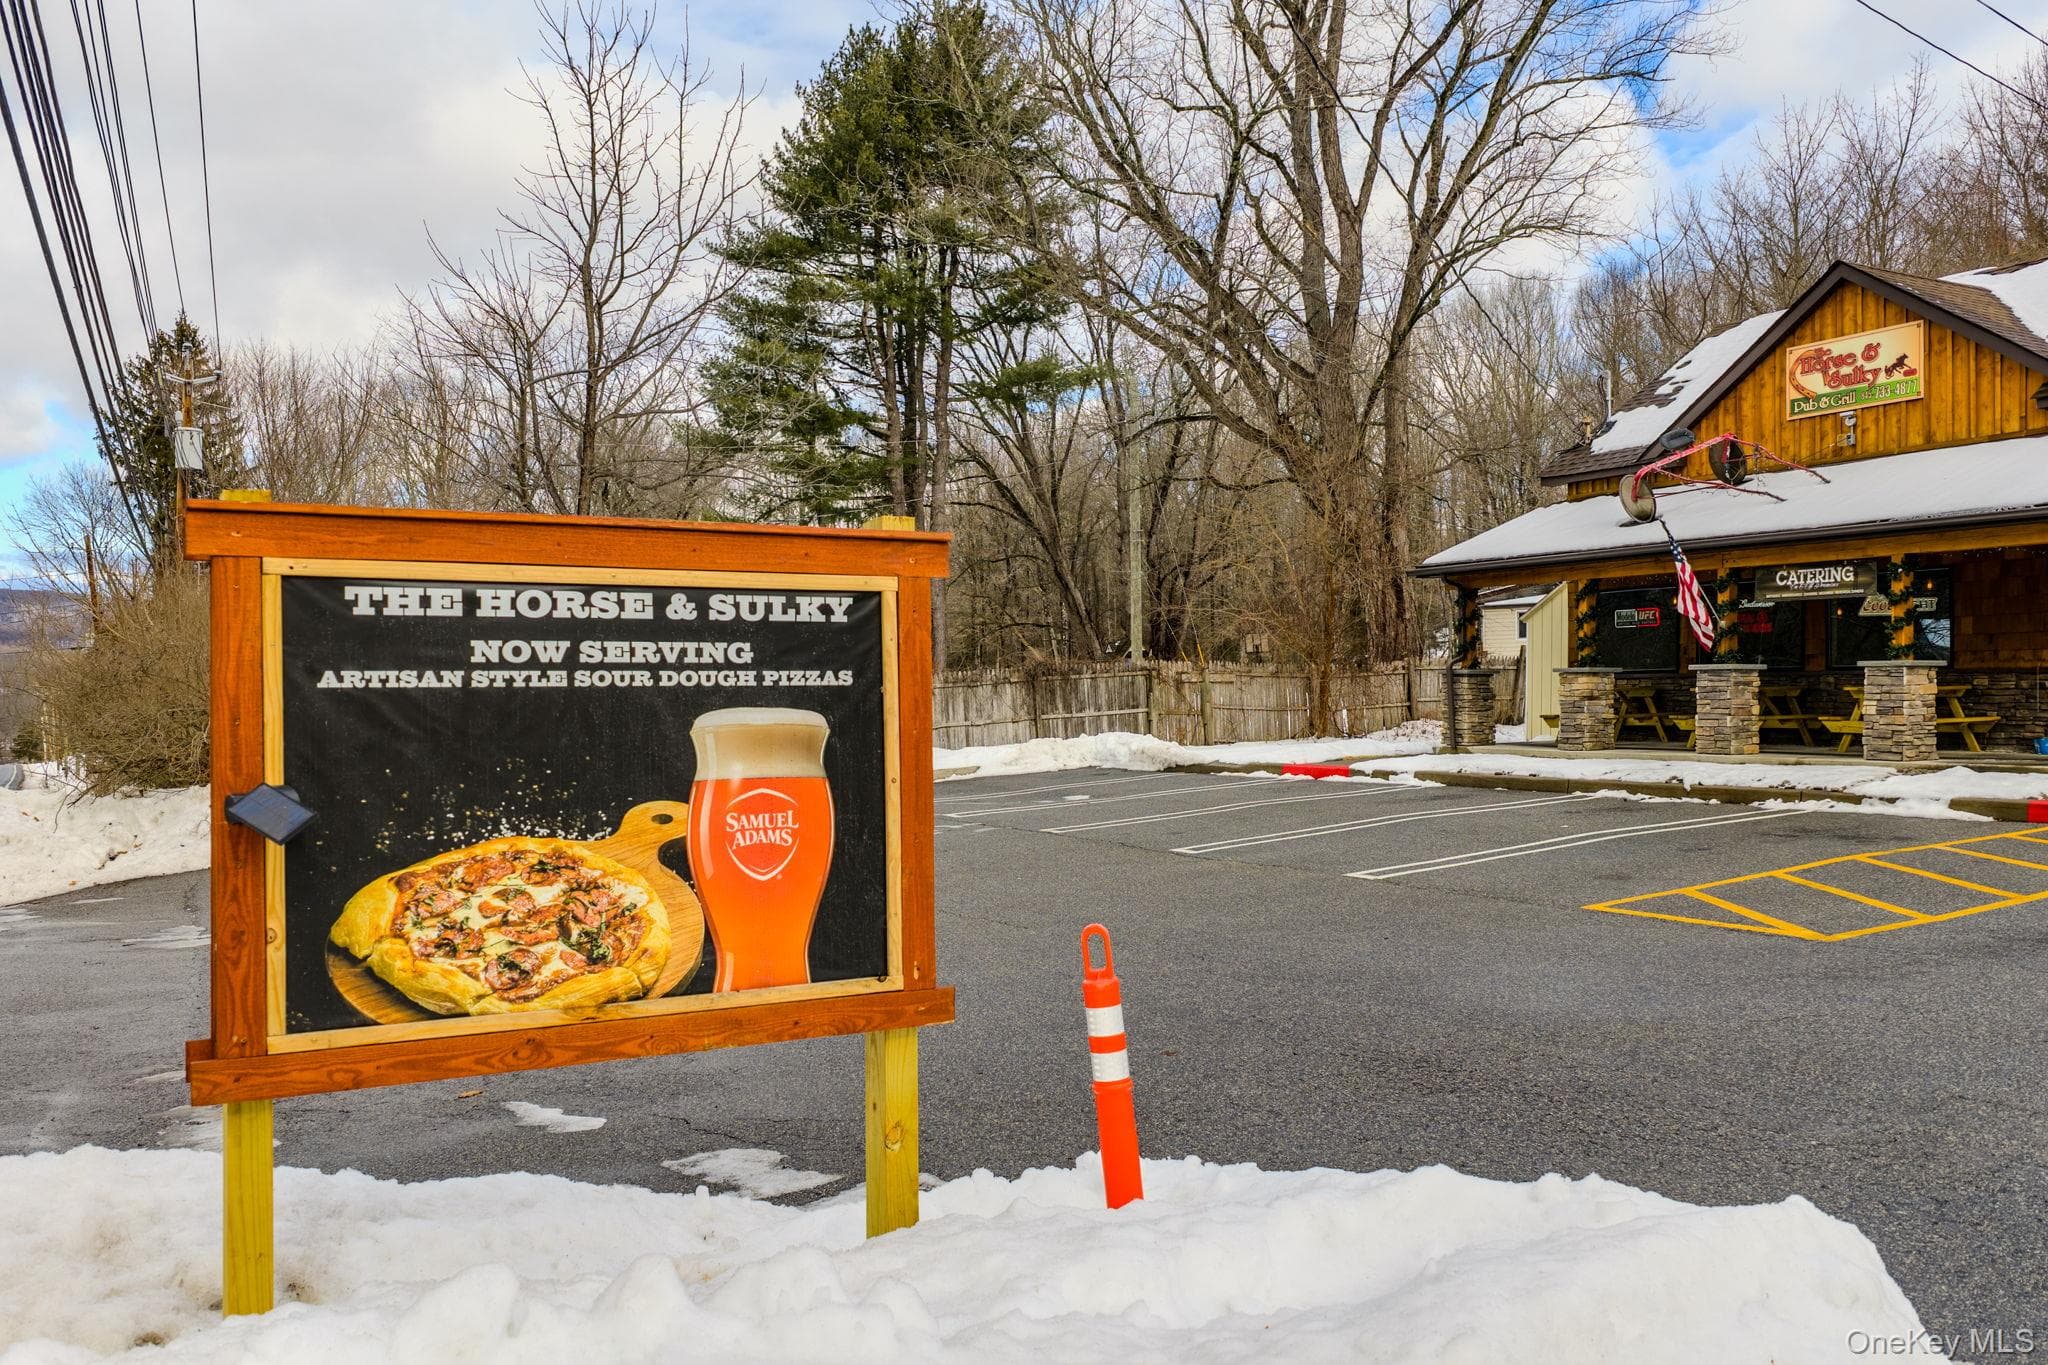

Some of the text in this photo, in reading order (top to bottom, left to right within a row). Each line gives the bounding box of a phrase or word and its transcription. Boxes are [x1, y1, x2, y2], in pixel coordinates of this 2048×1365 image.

[1799, 342, 1881, 376] Horse &
[1827, 364, 1881, 390] Sulky
[1794, 391, 1856, 413] Pub & Grill
[1776, 566, 1855, 586] CATERING
[344, 586, 853, 623] THE HORSE & SULKY
[1638, 611, 1656, 620] UFC
[470, 640, 754, 664] NOW SERVING
[317, 670, 853, 688] ARTISAN STYLE SOUR DOUGH PIZZAS
[725, 809, 800, 833] SAMUEL
[732, 828, 793, 851] ADAMS
